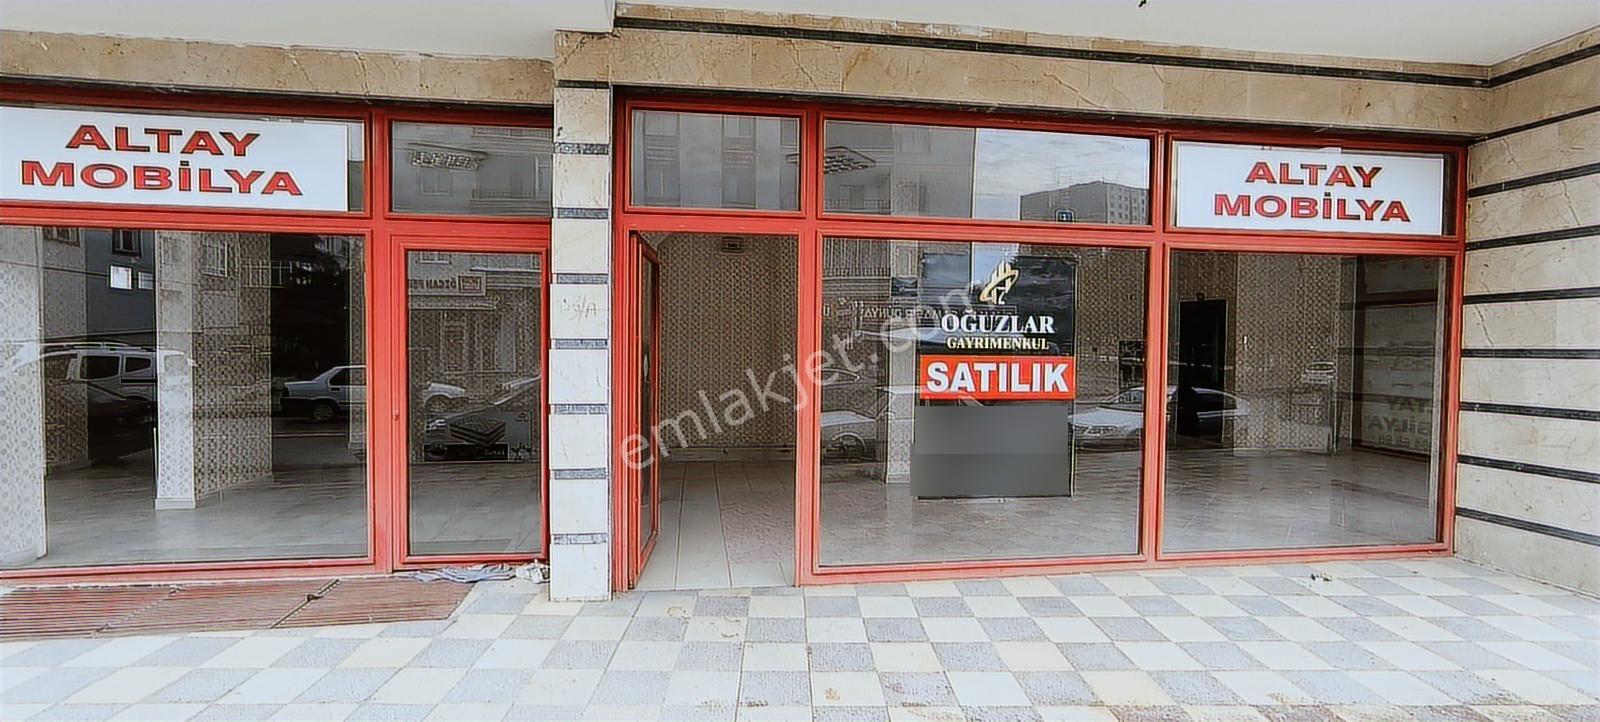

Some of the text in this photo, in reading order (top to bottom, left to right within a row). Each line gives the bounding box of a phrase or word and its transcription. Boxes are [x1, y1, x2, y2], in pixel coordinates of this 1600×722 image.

[65, 124, 260, 157] ALTAY
[21, 160, 303, 196] MOBİLYA
[1245, 161, 1383, 188] ALTAY
[1214, 191, 1411, 222] MOBİLYA
[941, 309, 1056, 334] OĞUZLAR
[926, 361, 1070, 393] SATILIK
